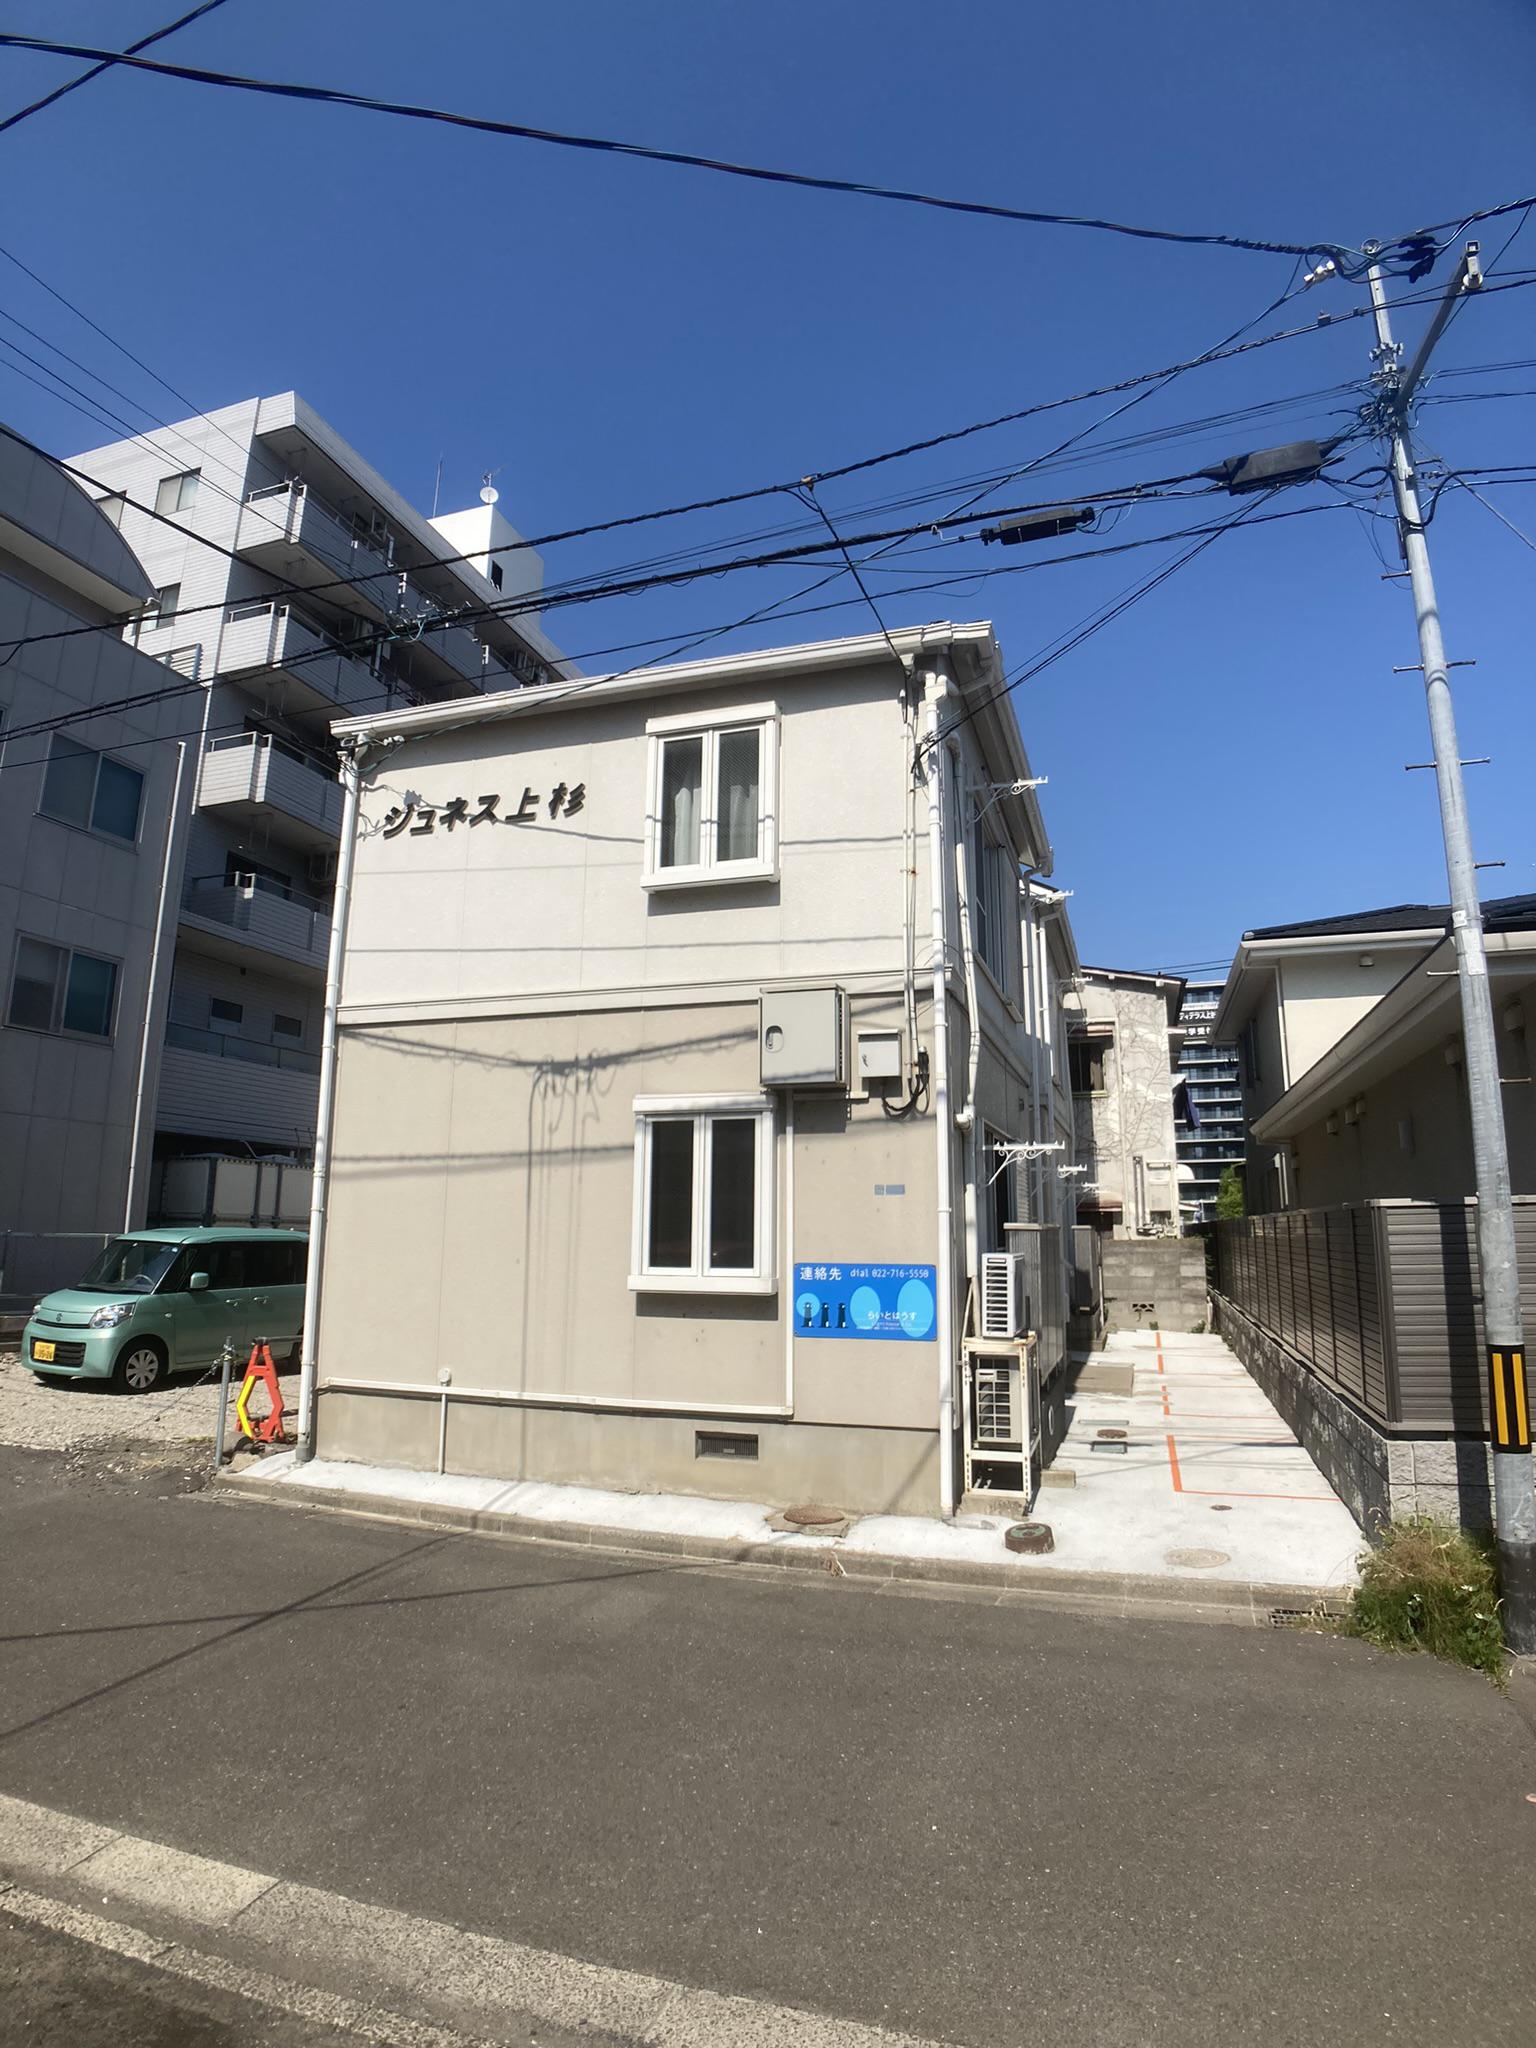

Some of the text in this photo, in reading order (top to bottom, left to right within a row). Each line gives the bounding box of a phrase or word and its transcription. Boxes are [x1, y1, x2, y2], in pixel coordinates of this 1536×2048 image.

[383, 782, 586, 840] ジュネス上杉
[799, 1266, 842, 1281] 連絡先
[850, 1268, 869, 1278] dial
